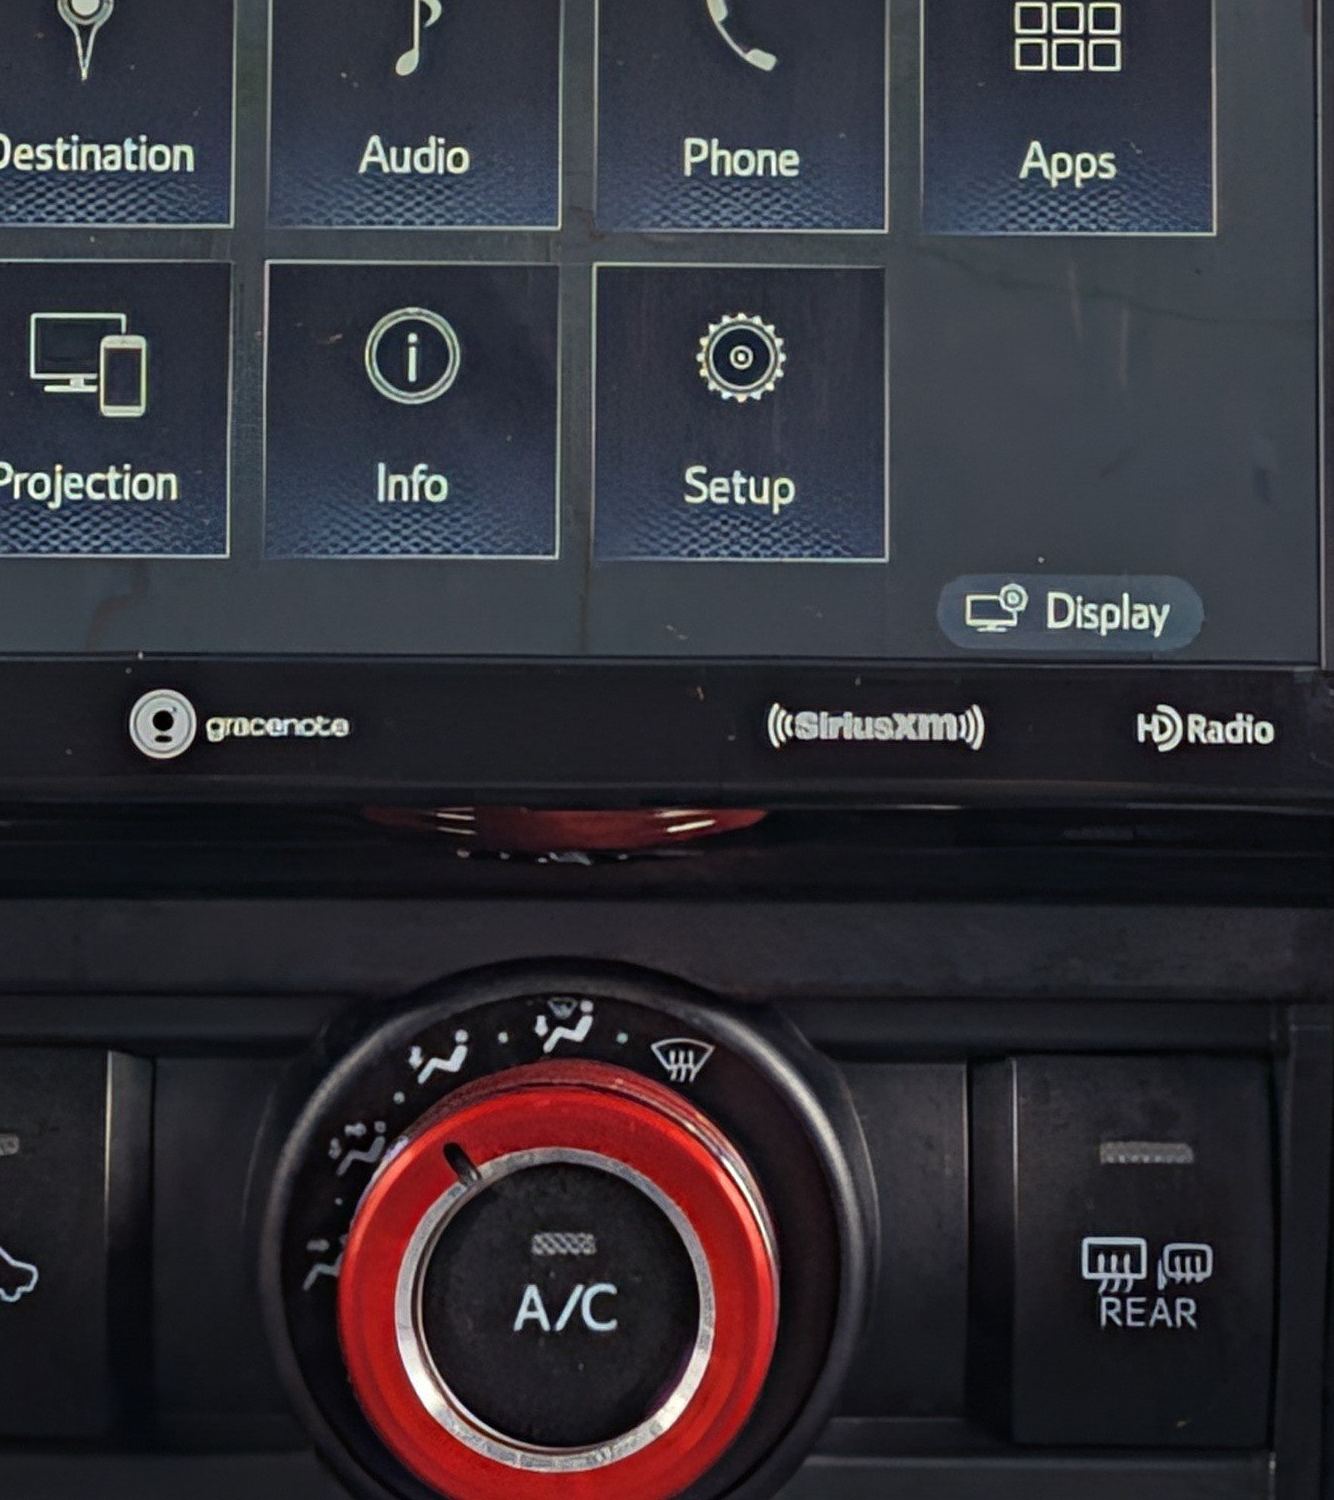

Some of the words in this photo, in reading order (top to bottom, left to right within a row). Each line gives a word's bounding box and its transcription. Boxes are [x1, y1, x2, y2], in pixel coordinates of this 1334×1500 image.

[358, 134, 470, 175] Audio
[684, 137, 800, 177] Phone
[1019, 140, 1117, 189] Apps
[377, 462, 449, 503] Info
[684, 465, 796, 515] Setup
[1046, 591, 1171, 638] Display
[1187, 712, 1275, 745] Radio
[513, 1283, 618, 1332] A/C
[1100, 1297, 1198, 1329] REAR
